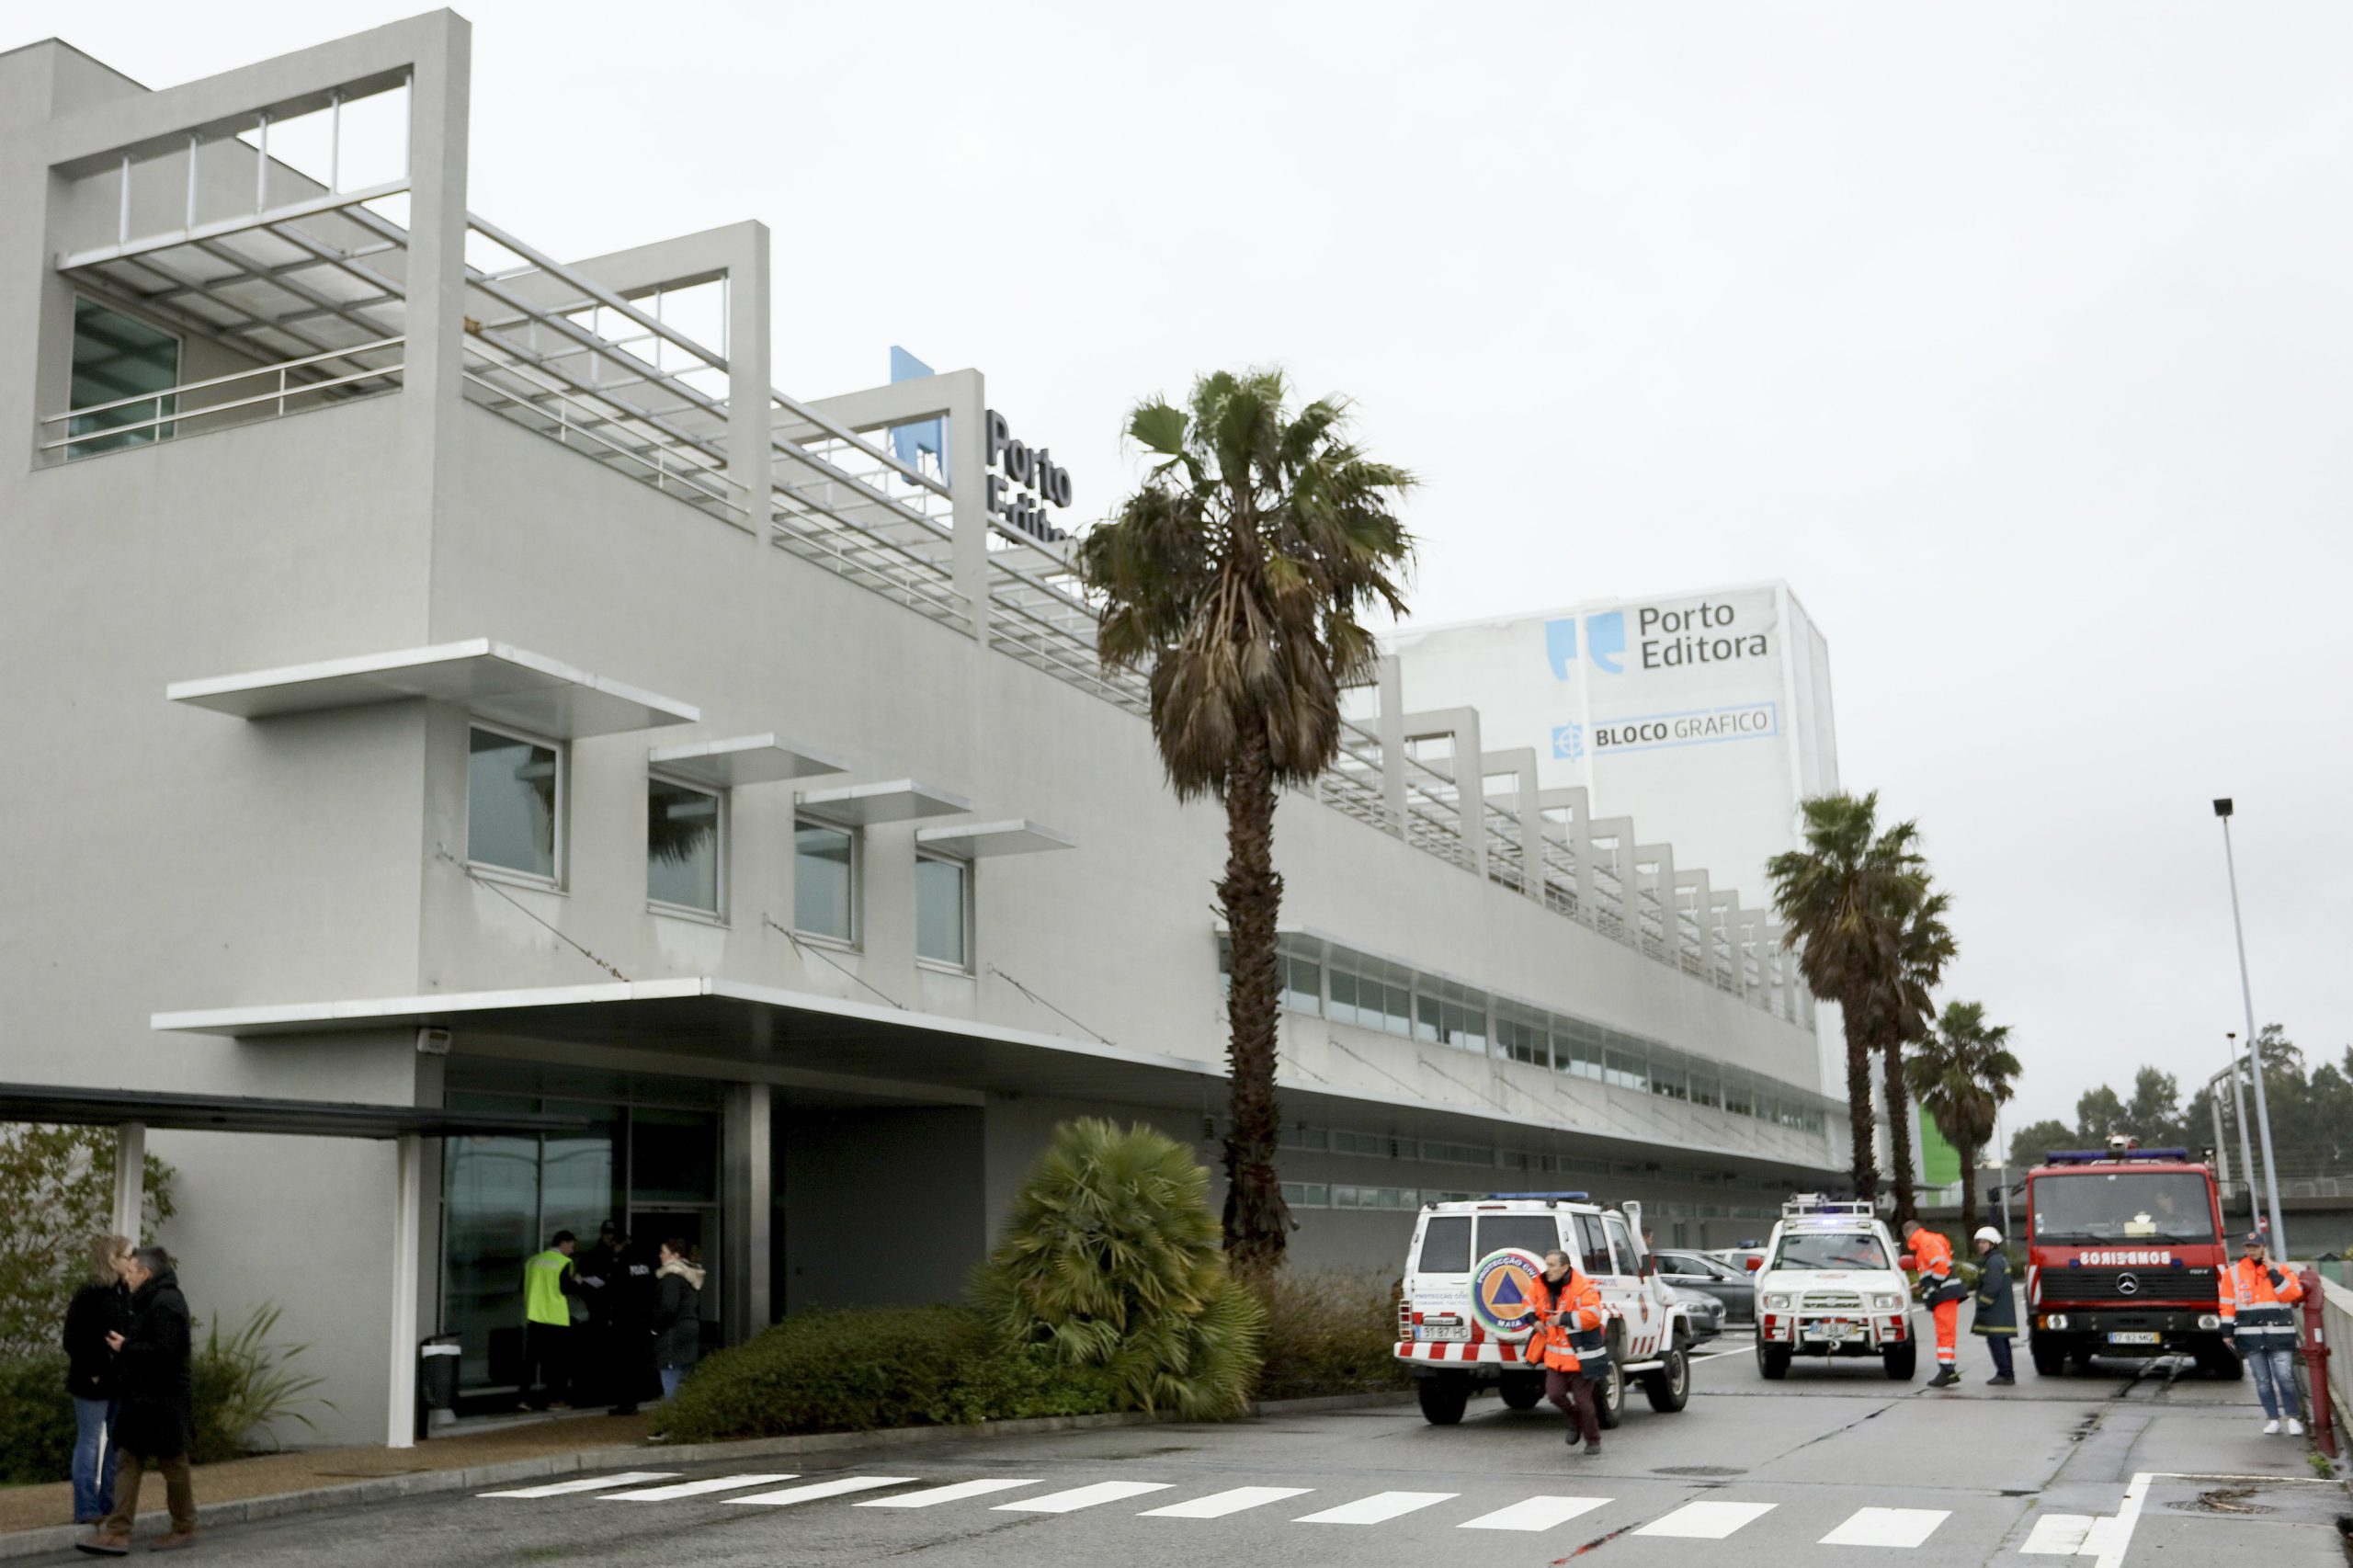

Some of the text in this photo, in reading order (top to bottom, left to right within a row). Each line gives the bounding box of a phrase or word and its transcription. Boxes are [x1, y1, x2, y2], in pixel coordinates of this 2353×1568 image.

[985, 409, 1072, 507] Porto
[1639, 602, 1735, 636] Porto
[1642, 633, 1767, 669] Editora
[1596, 722, 1668, 746] BLOCO
[1496, 1319, 1522, 1328] MAIA
